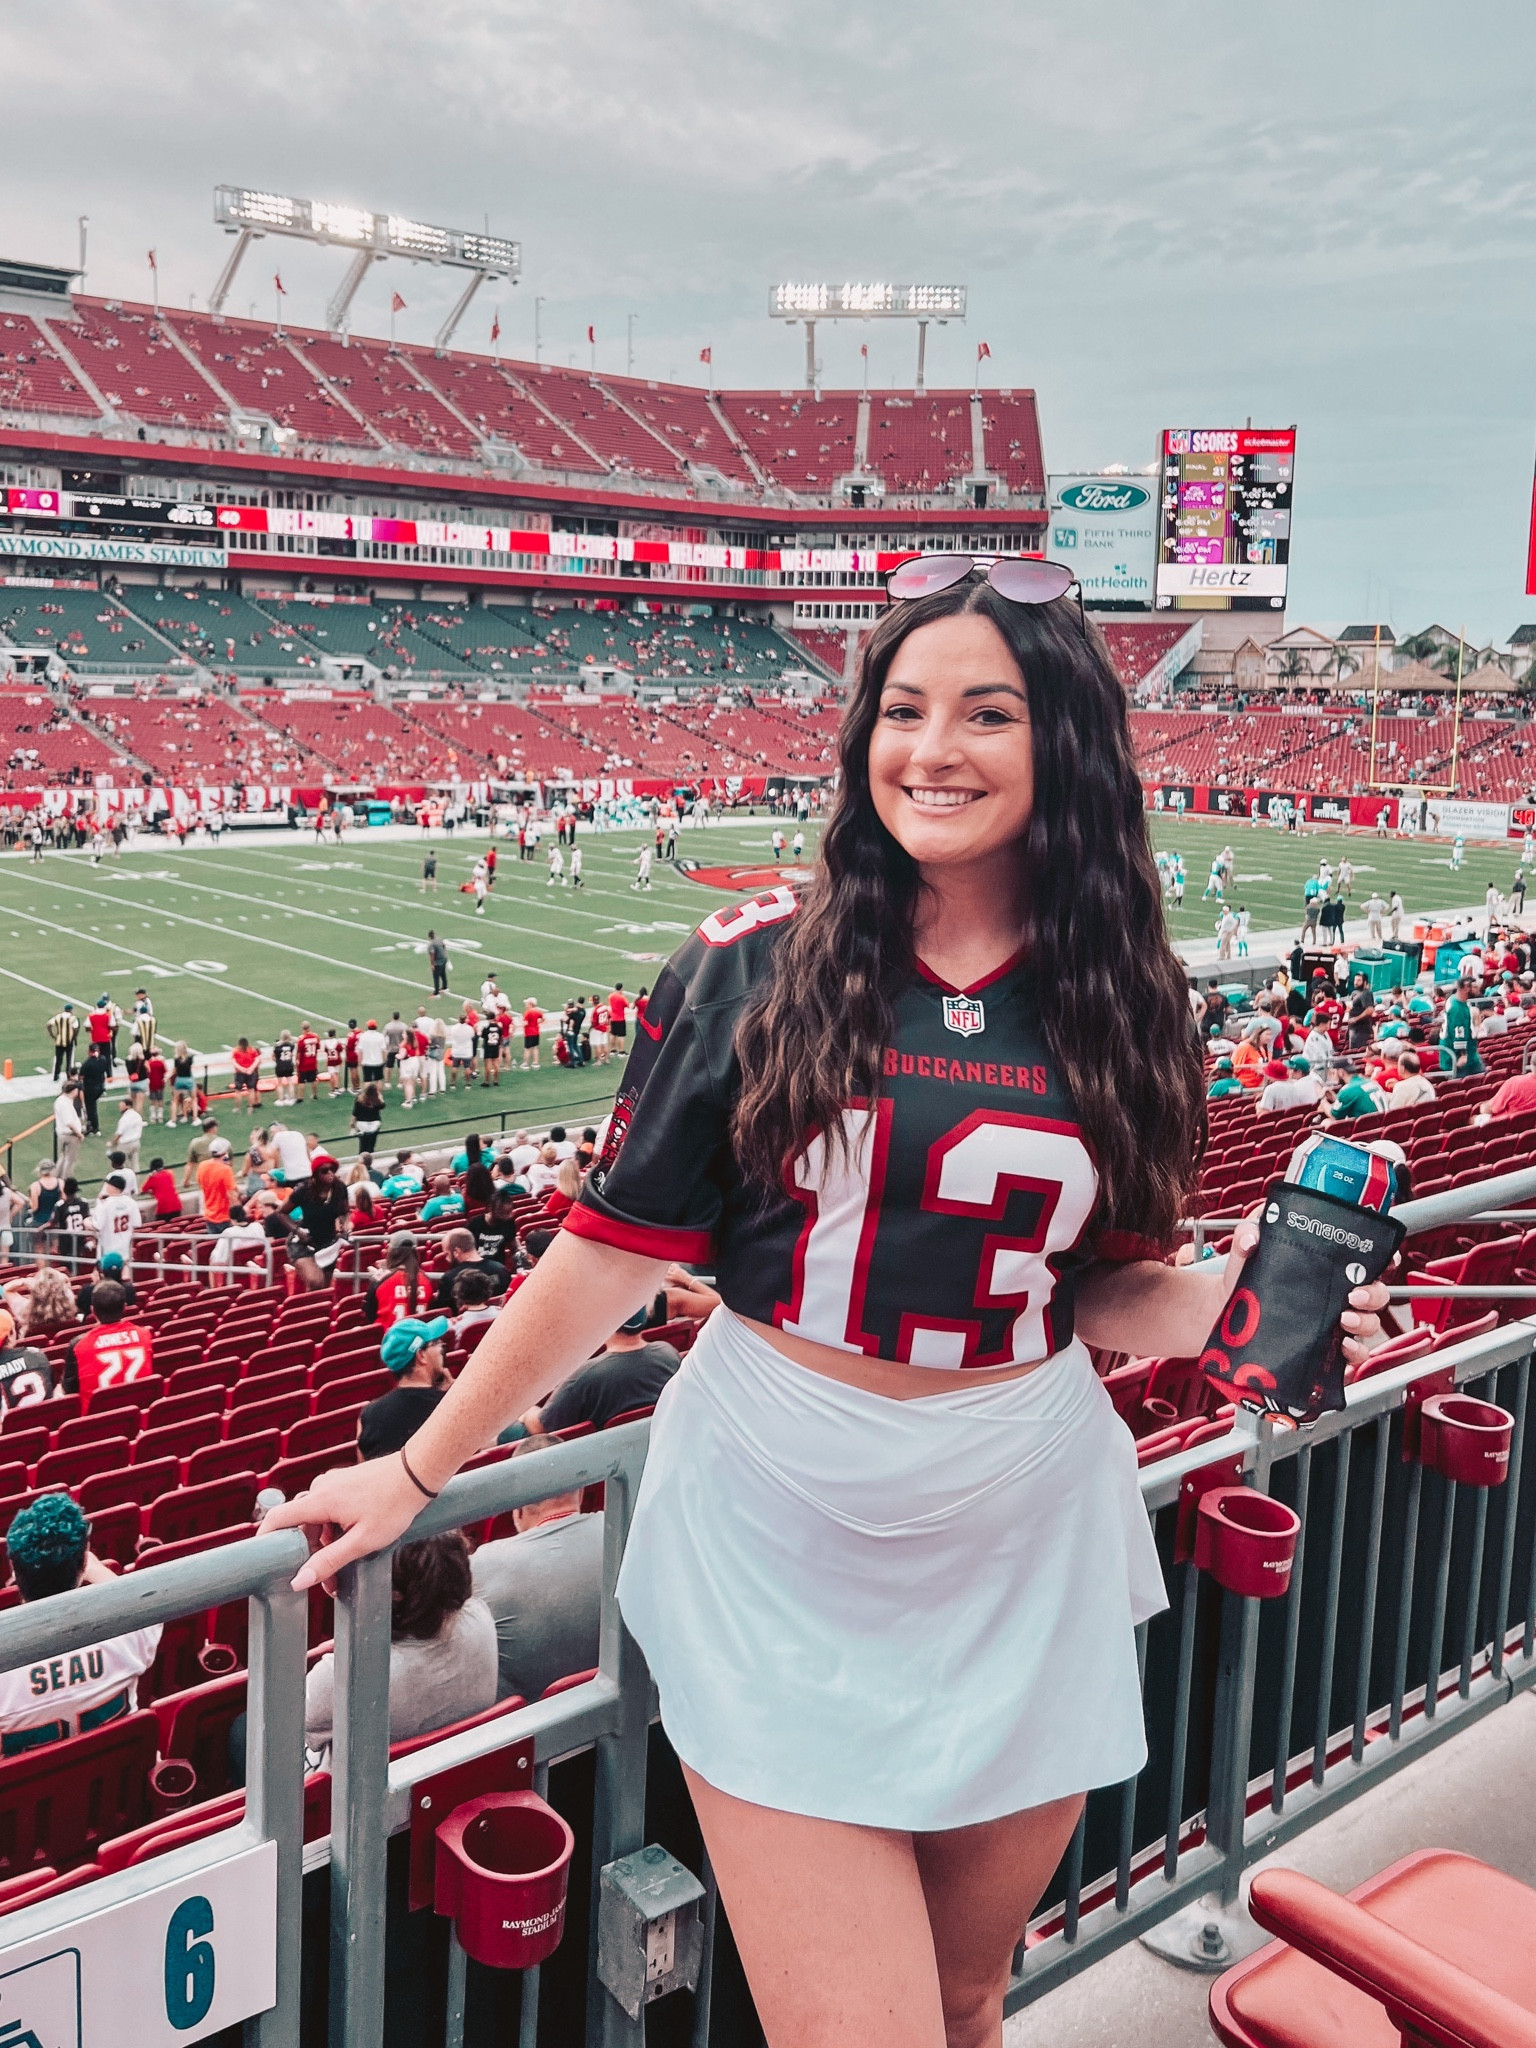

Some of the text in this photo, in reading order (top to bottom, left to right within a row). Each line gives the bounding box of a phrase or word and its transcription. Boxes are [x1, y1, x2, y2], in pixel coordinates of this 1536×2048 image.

[1193, 432, 1238, 453] SCORES
[1244, 437, 1291, 448] ticketmaster
[1075, 484, 1132, 509] Ford
[1084, 529, 1152, 538] FIFTH THIRD
[1084, 540, 1115, 549] BANK
[84, 543, 146, 561] JAMES
[150, 548, 226, 567] STADIUM
[1189, 567, 1251, 587] Hertz
[1477, 807, 1507, 817] VISION
[1513, 809, 1536, 826] 40
[951, 1010, 979, 1029] NFL
[883, 1046, 1048, 1096] BUCCANEERS
[114, 1214, 130, 1234] 12
[772, 1097, 1101, 1371] 13
[1286, 1210, 1375, 1254] #GOBUCS
[95, 1331, 130, 1349] JONES
[96, 1346, 146, 1389] 77
[30, 1649, 105, 1696] SEAU
[502, 1912, 550, 1929] RAYMOND
[521, 1913, 558, 1937] STADIUM
[164, 1895, 216, 2031] 6
